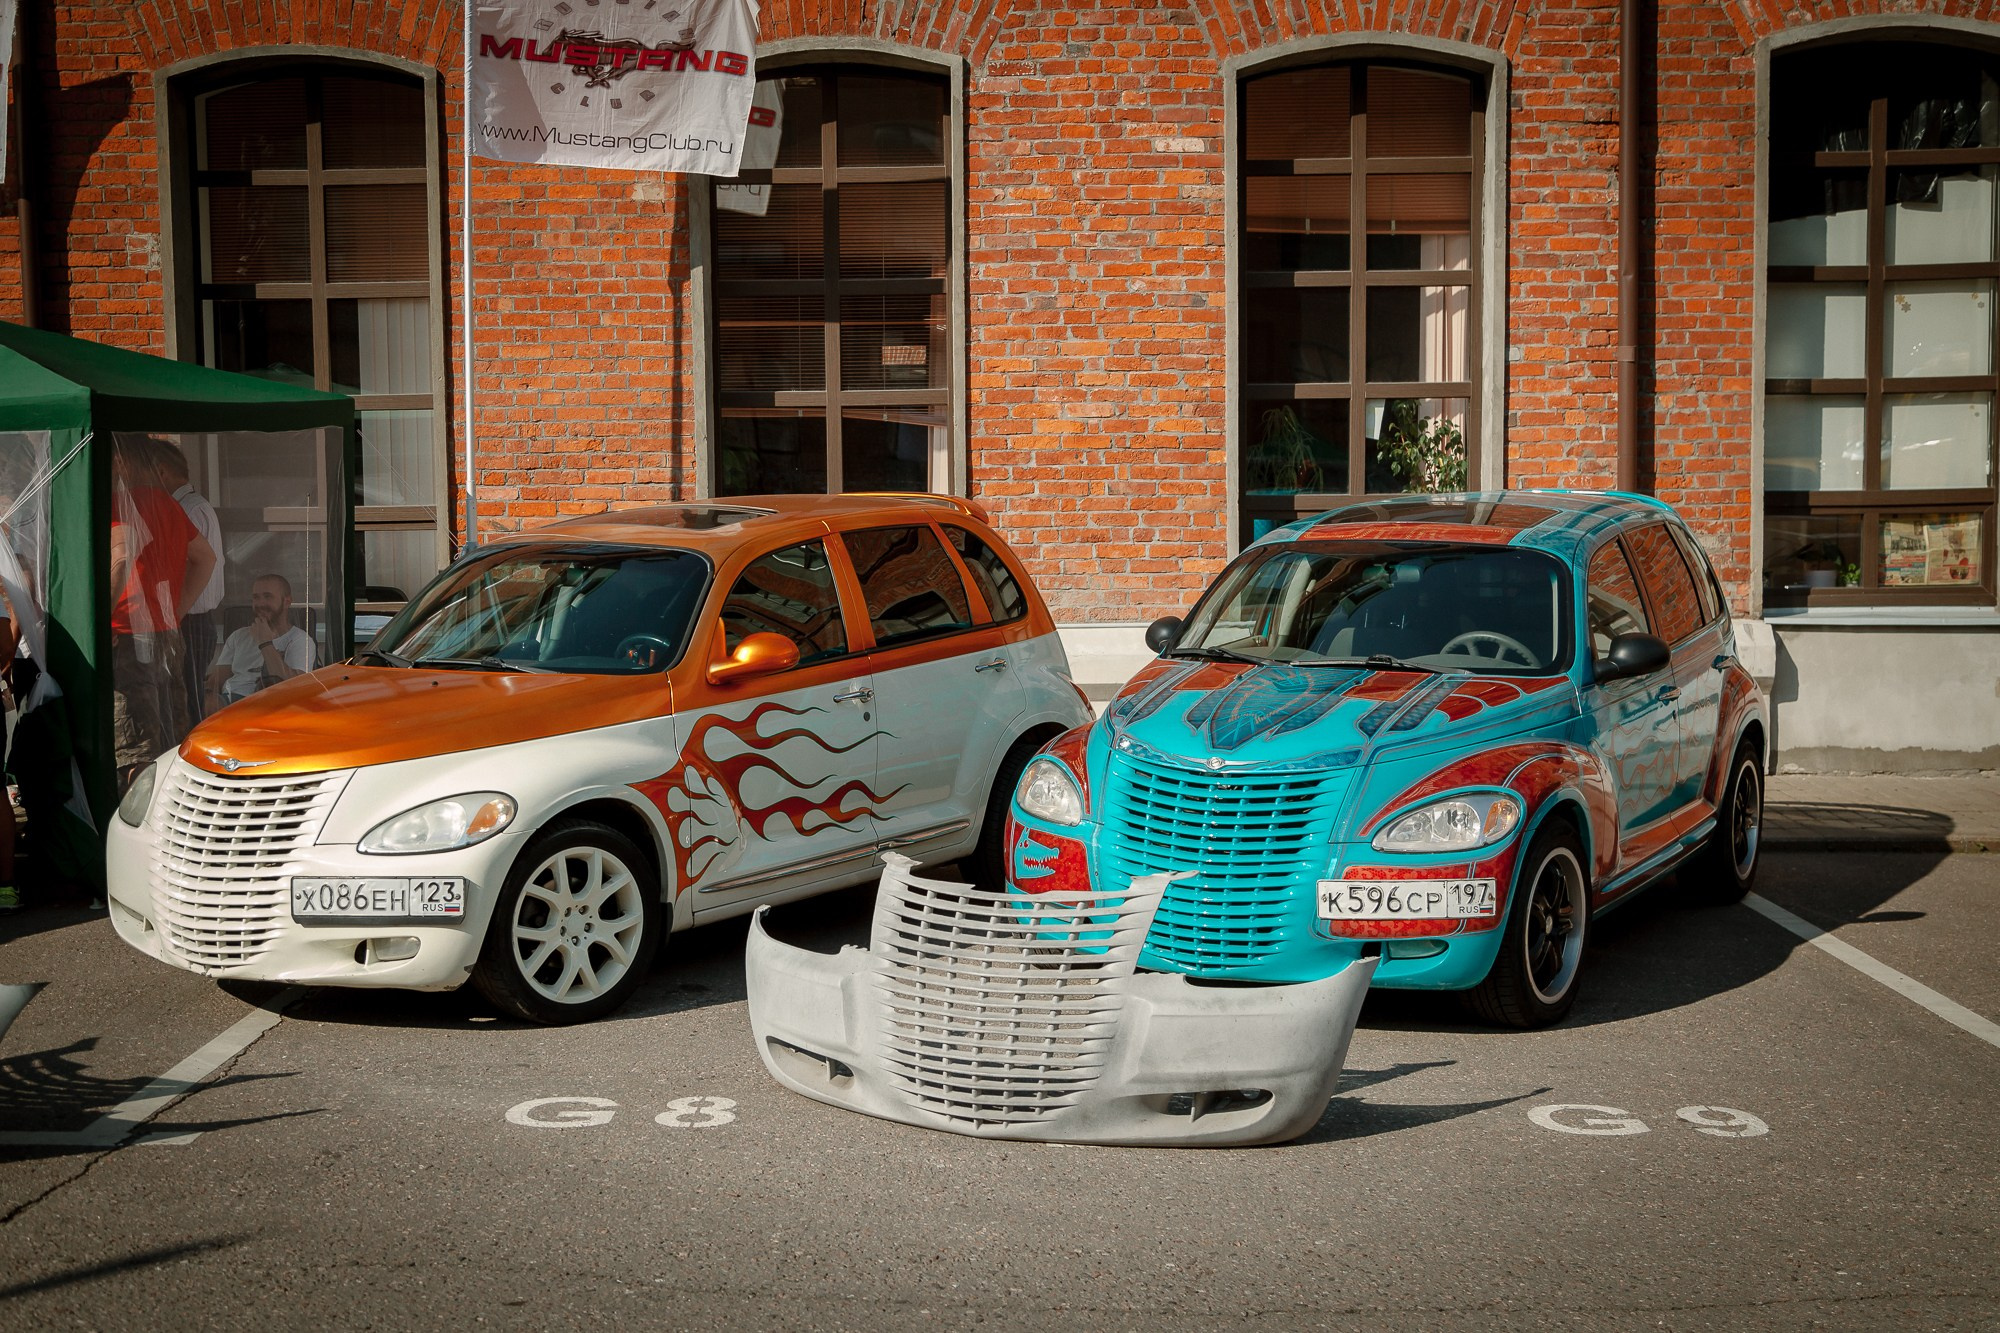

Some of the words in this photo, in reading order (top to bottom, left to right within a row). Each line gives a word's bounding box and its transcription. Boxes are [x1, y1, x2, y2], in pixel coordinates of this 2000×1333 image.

[479, 33, 749, 76] MUSTANG
[477, 122, 734, 155] www.MustangClub.ru
[413, 881, 456, 903] 123
[1449, 882, 1489, 905] 197
[422, 903, 444, 912] RUS
[1458, 905, 1480, 914] RUS
